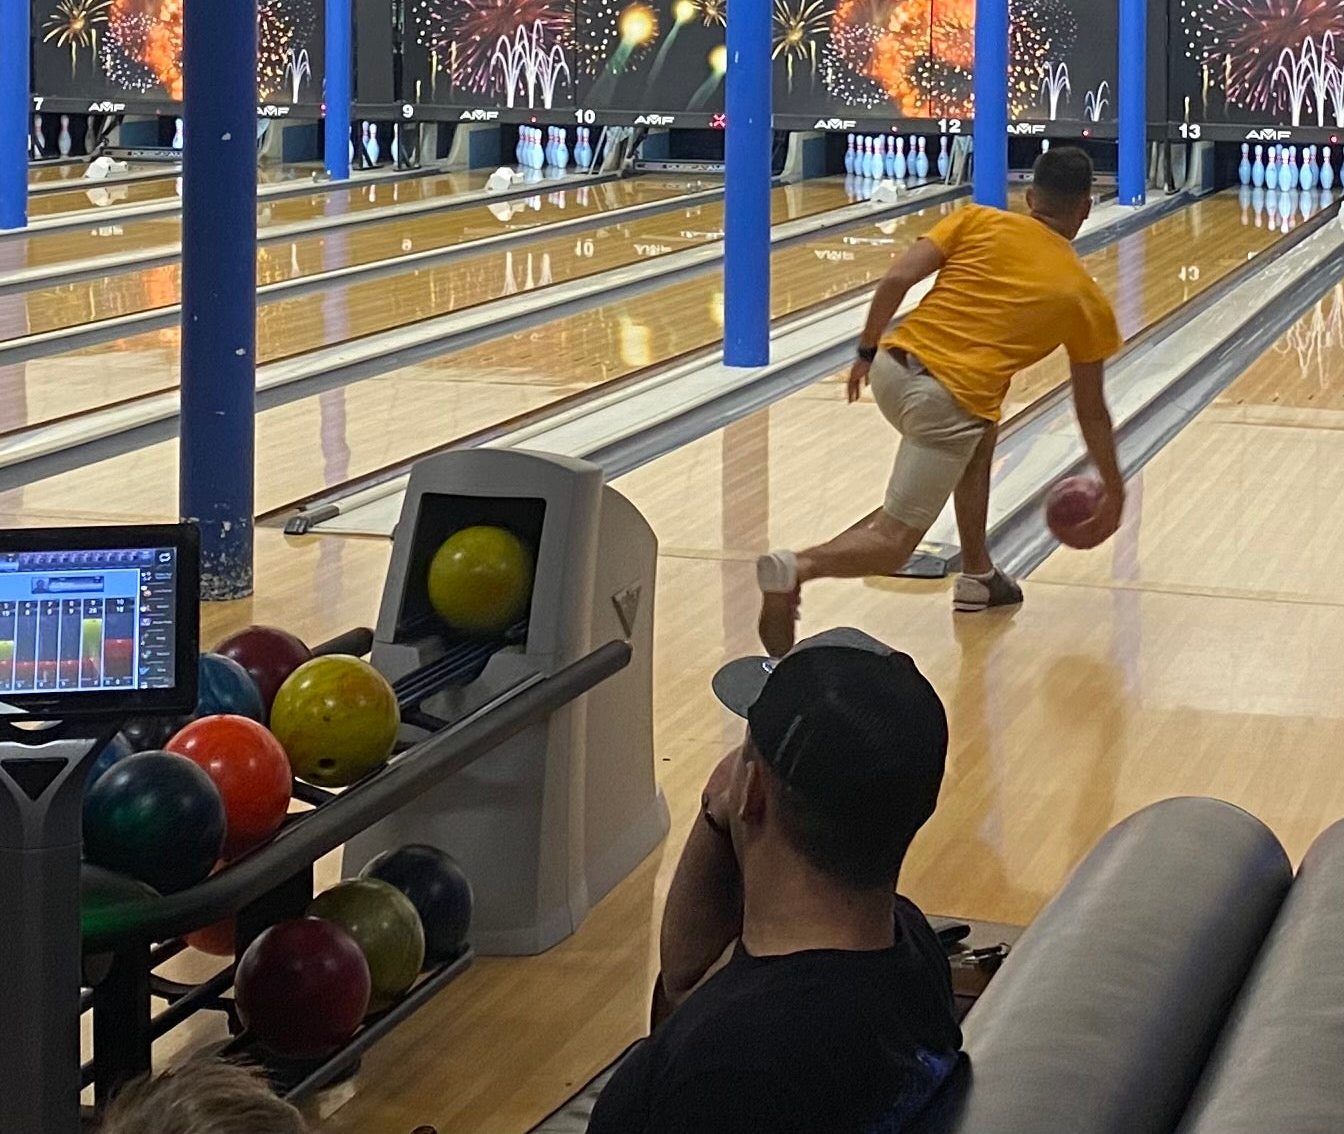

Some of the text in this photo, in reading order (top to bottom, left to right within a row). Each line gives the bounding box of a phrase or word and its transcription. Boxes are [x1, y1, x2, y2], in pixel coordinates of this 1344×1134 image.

[33, 97, 44, 111] 7
[88, 101, 126, 113] AMF
[402, 104, 415, 118] 9
[459, 109, 500, 121] AMF
[574, 108, 596, 124] 10
[634, 114, 674, 126] AMF
[814, 118, 857, 130] AMF
[937, 118, 962, 134] 12
[1178, 122, 1202, 139] 13
[1245, 128, 1292, 141] AMF
